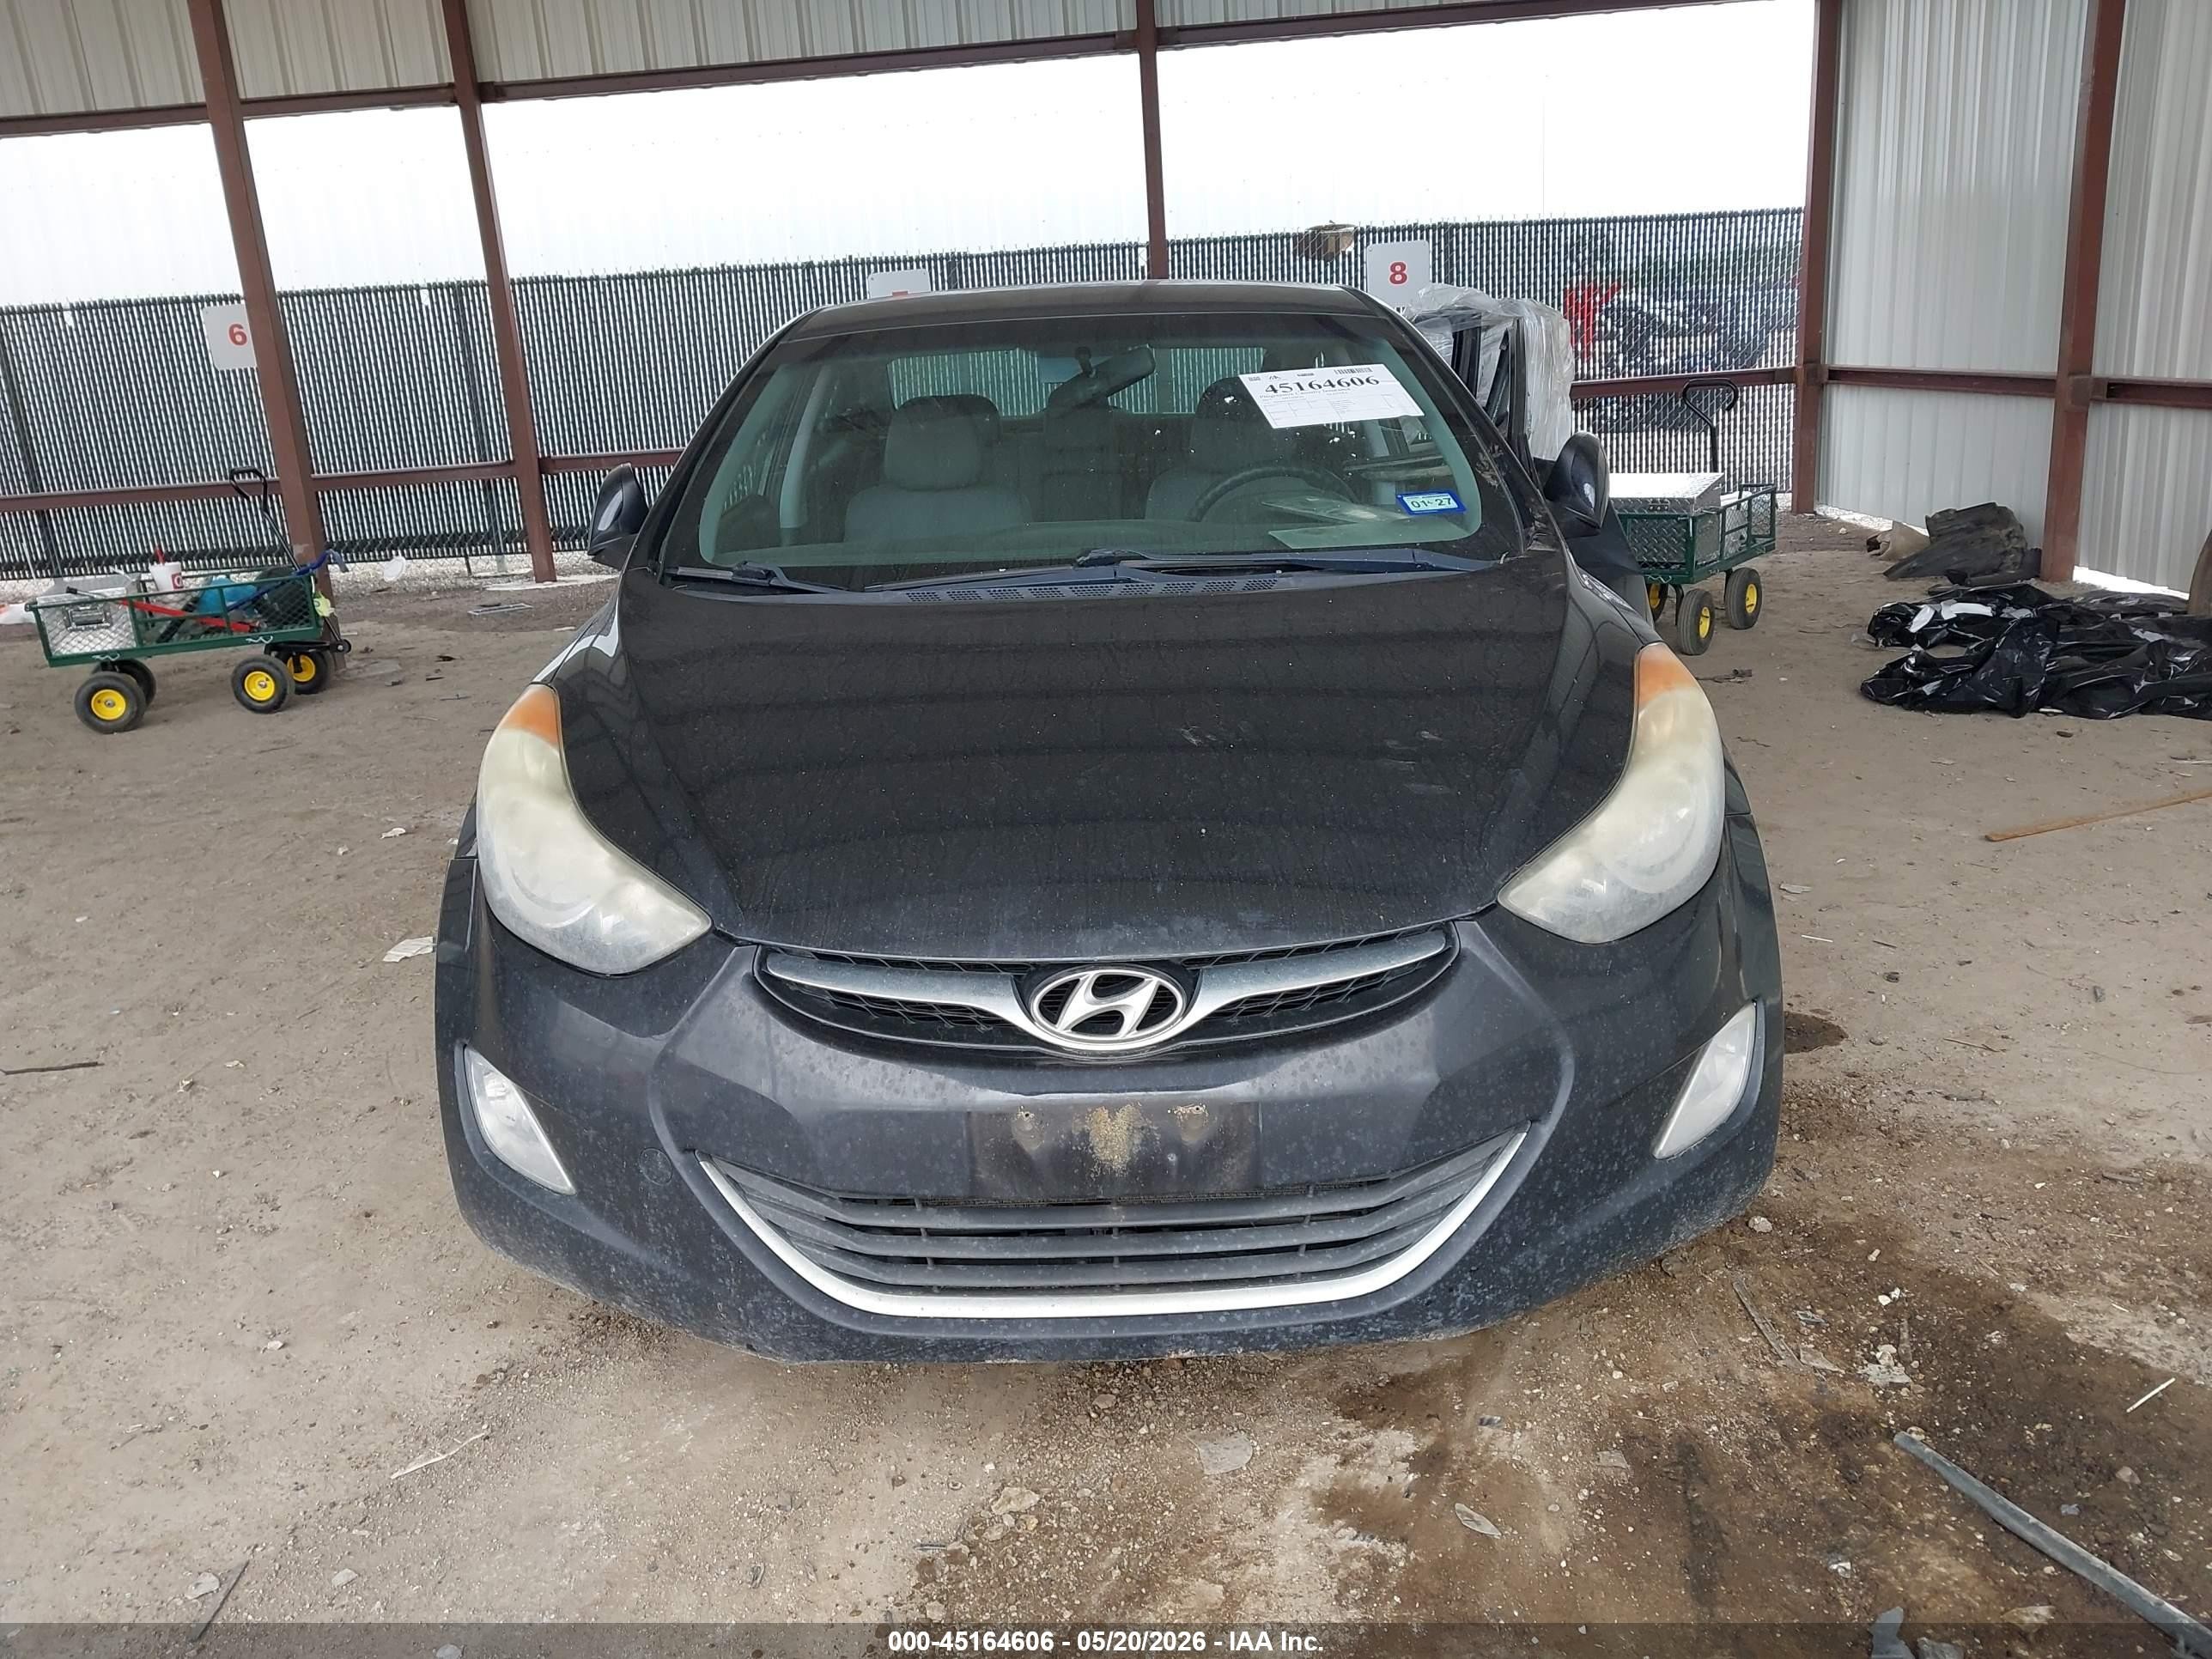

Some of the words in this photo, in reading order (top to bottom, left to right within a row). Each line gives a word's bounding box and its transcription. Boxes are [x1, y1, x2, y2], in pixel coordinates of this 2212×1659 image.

[1389, 261, 1407, 285] 8
[228, 323, 247, 346] 6
[1265, 375, 1380, 393] 45164606
